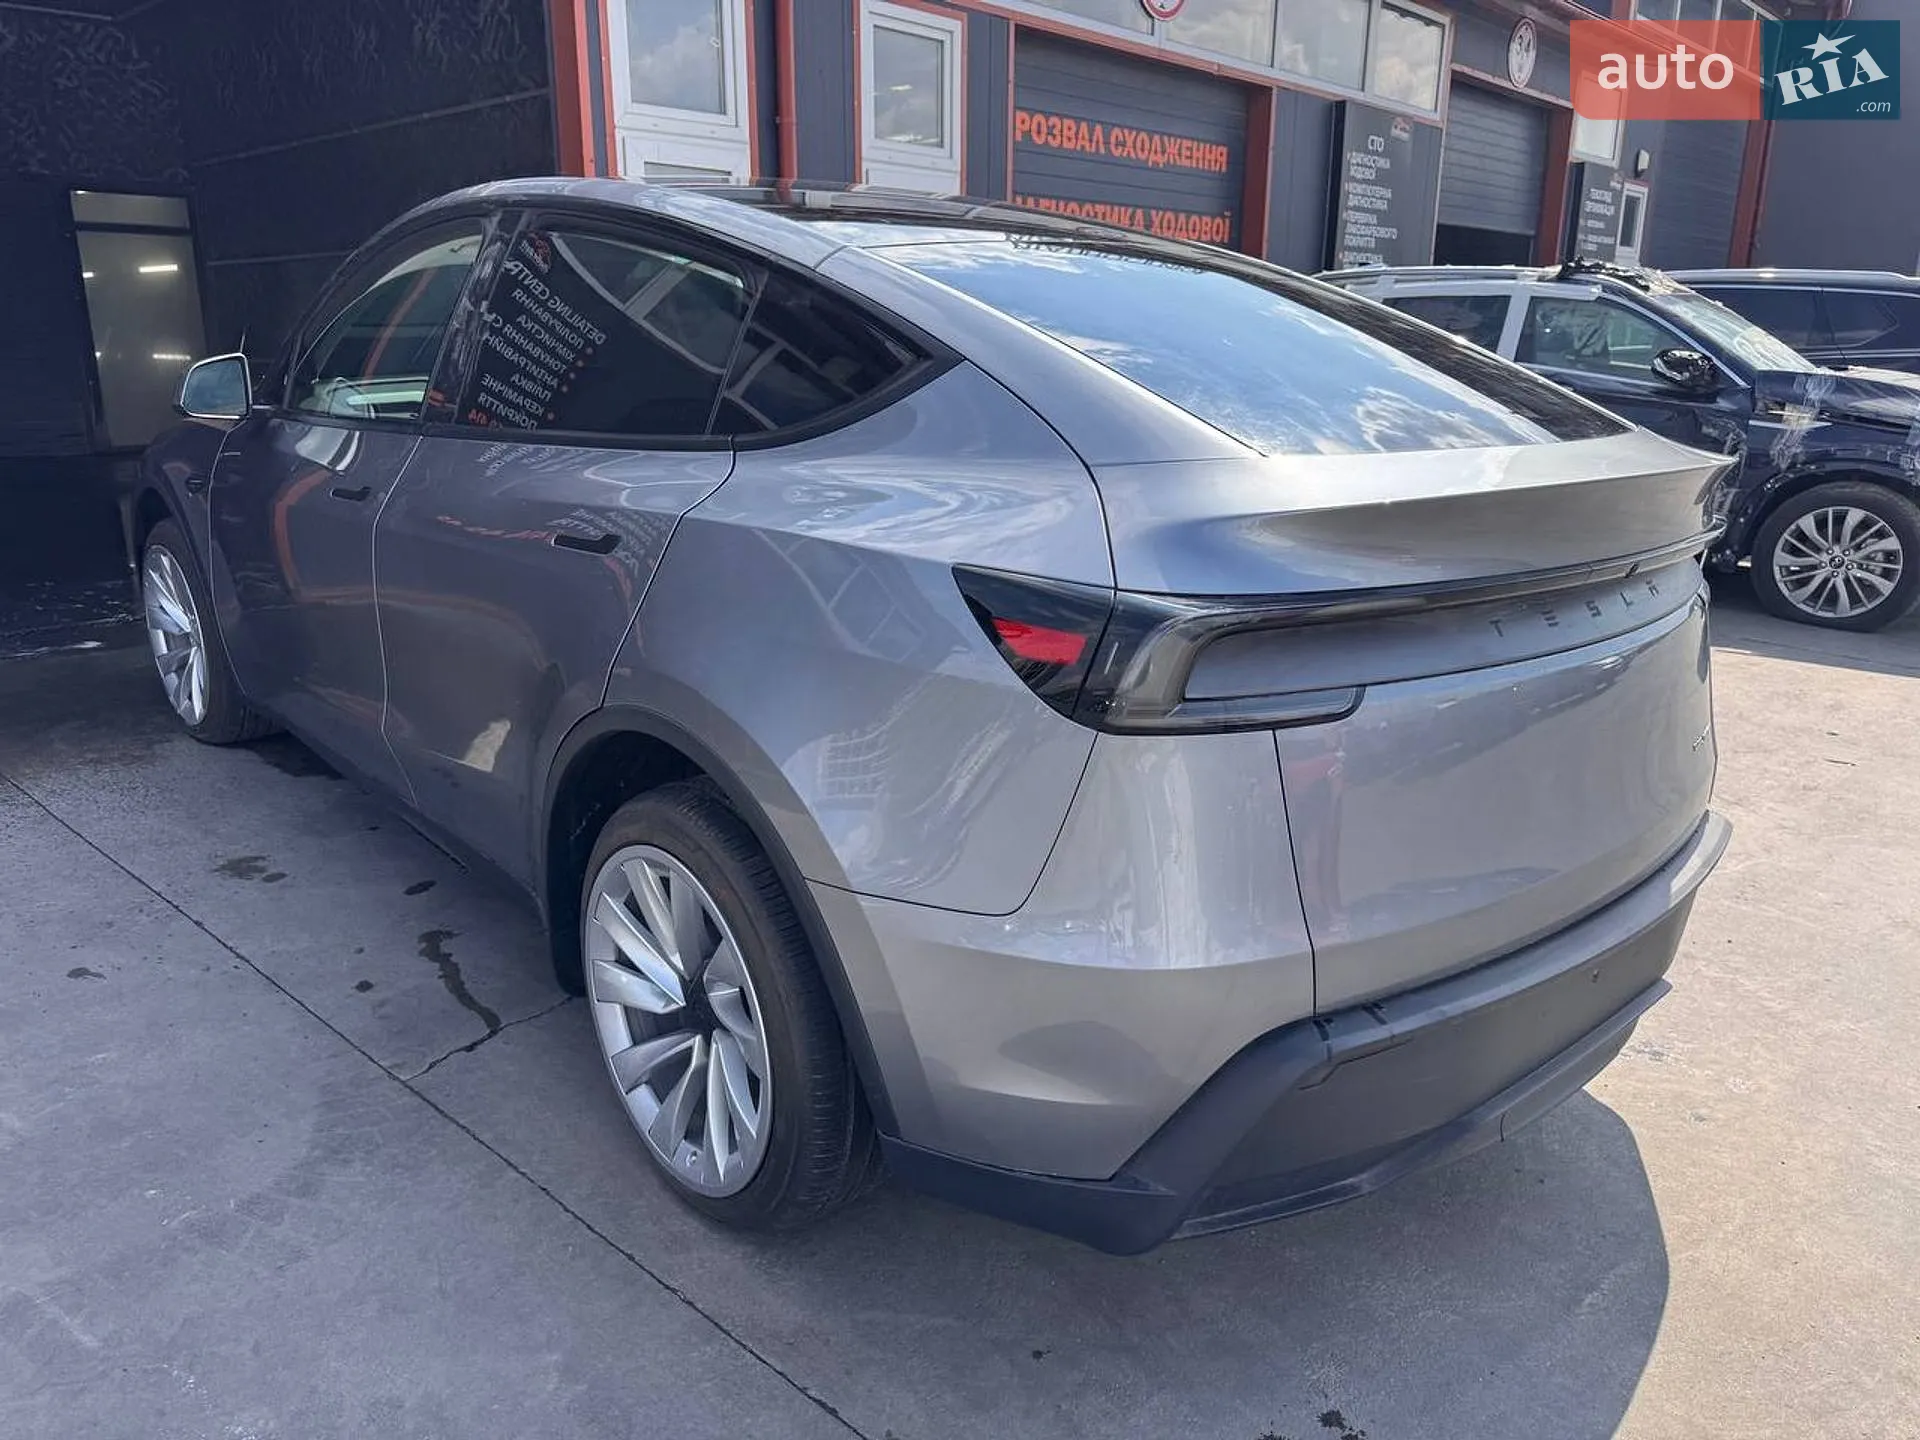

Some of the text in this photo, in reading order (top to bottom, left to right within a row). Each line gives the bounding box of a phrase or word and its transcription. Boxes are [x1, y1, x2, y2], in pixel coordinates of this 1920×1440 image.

[1015, 110, 1229, 173] РОЗВАЛ СХОДЖЕННЯ
[1152, 211, 1232, 244] ХОДОВОЇ
[1489, 578, 1660, 638] TESLA
